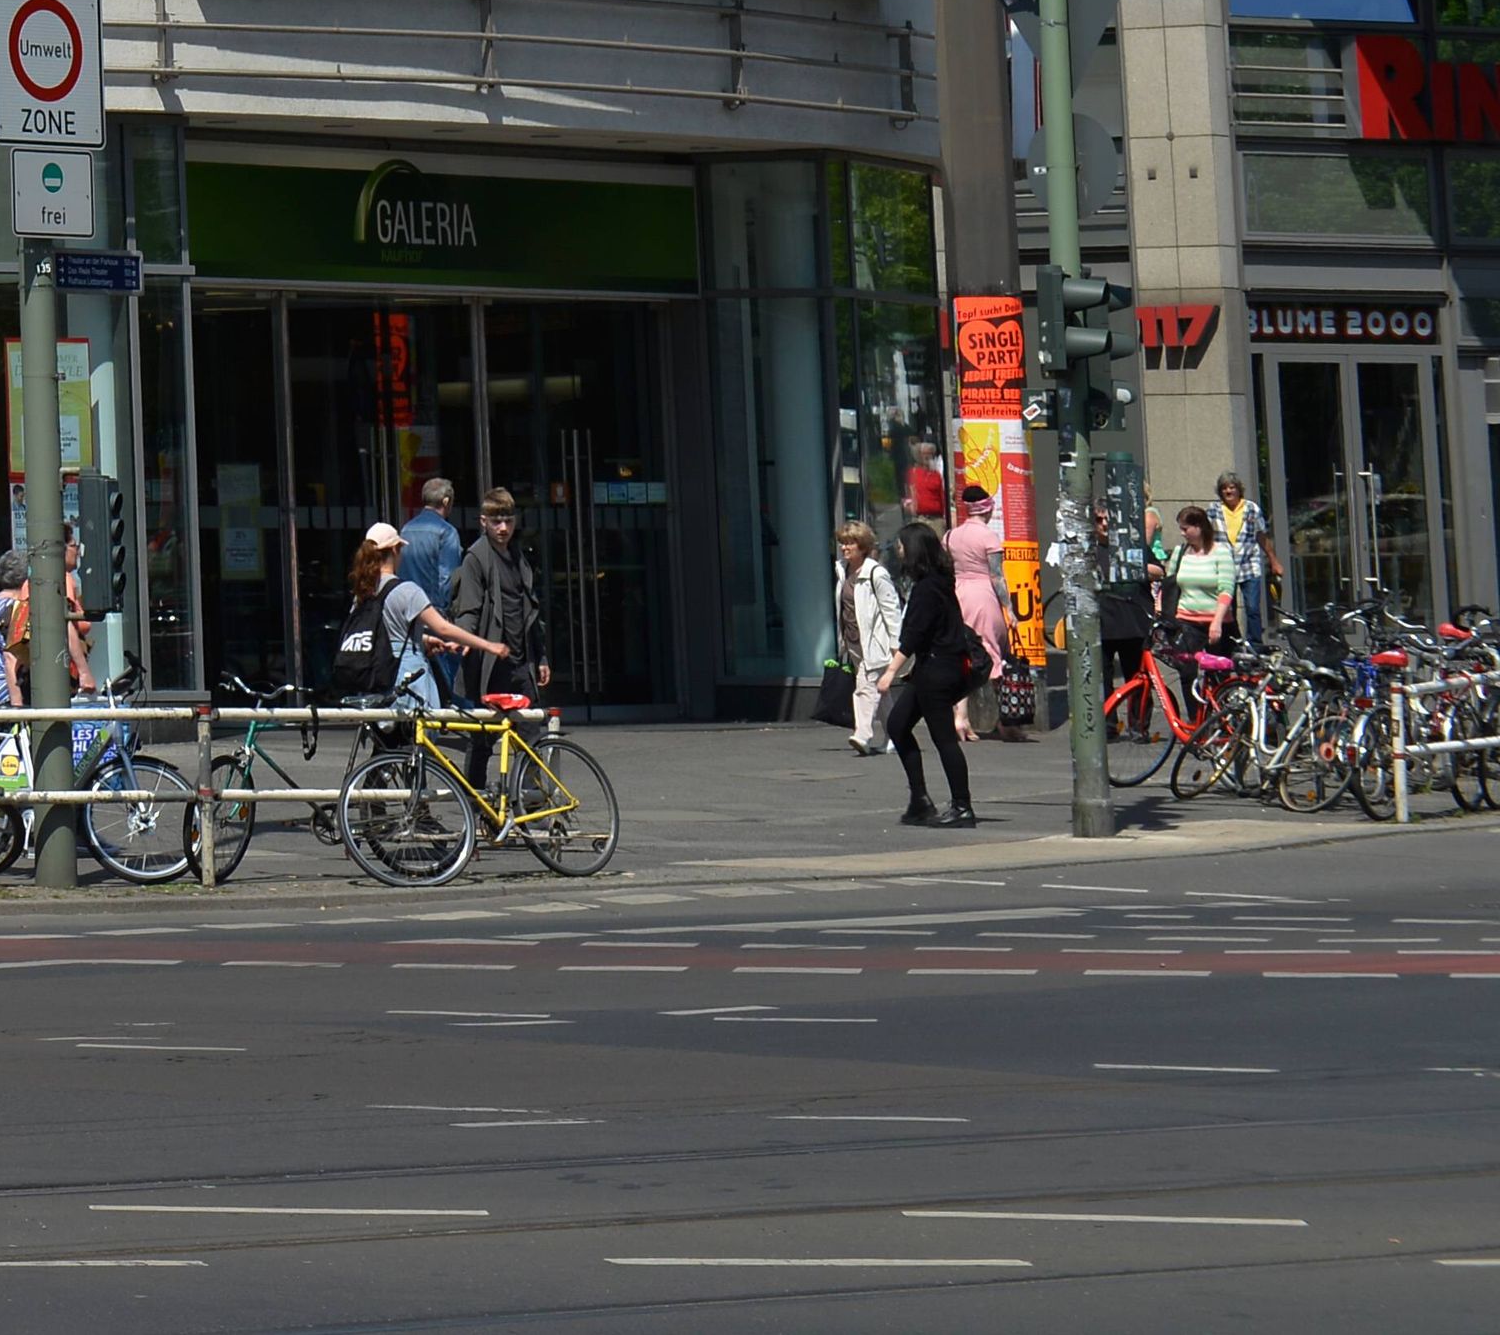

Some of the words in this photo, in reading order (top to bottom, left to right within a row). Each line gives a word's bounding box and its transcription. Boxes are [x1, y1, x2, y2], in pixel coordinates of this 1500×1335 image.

[19, 39, 72, 60] Umwelt
[21, 108, 76, 135] ZONE
[41, 206, 67, 226] frei
[376, 199, 477, 247] GALERIA
[1346, 311, 1434, 337] 2000
[340, 630, 373, 652] VANS
